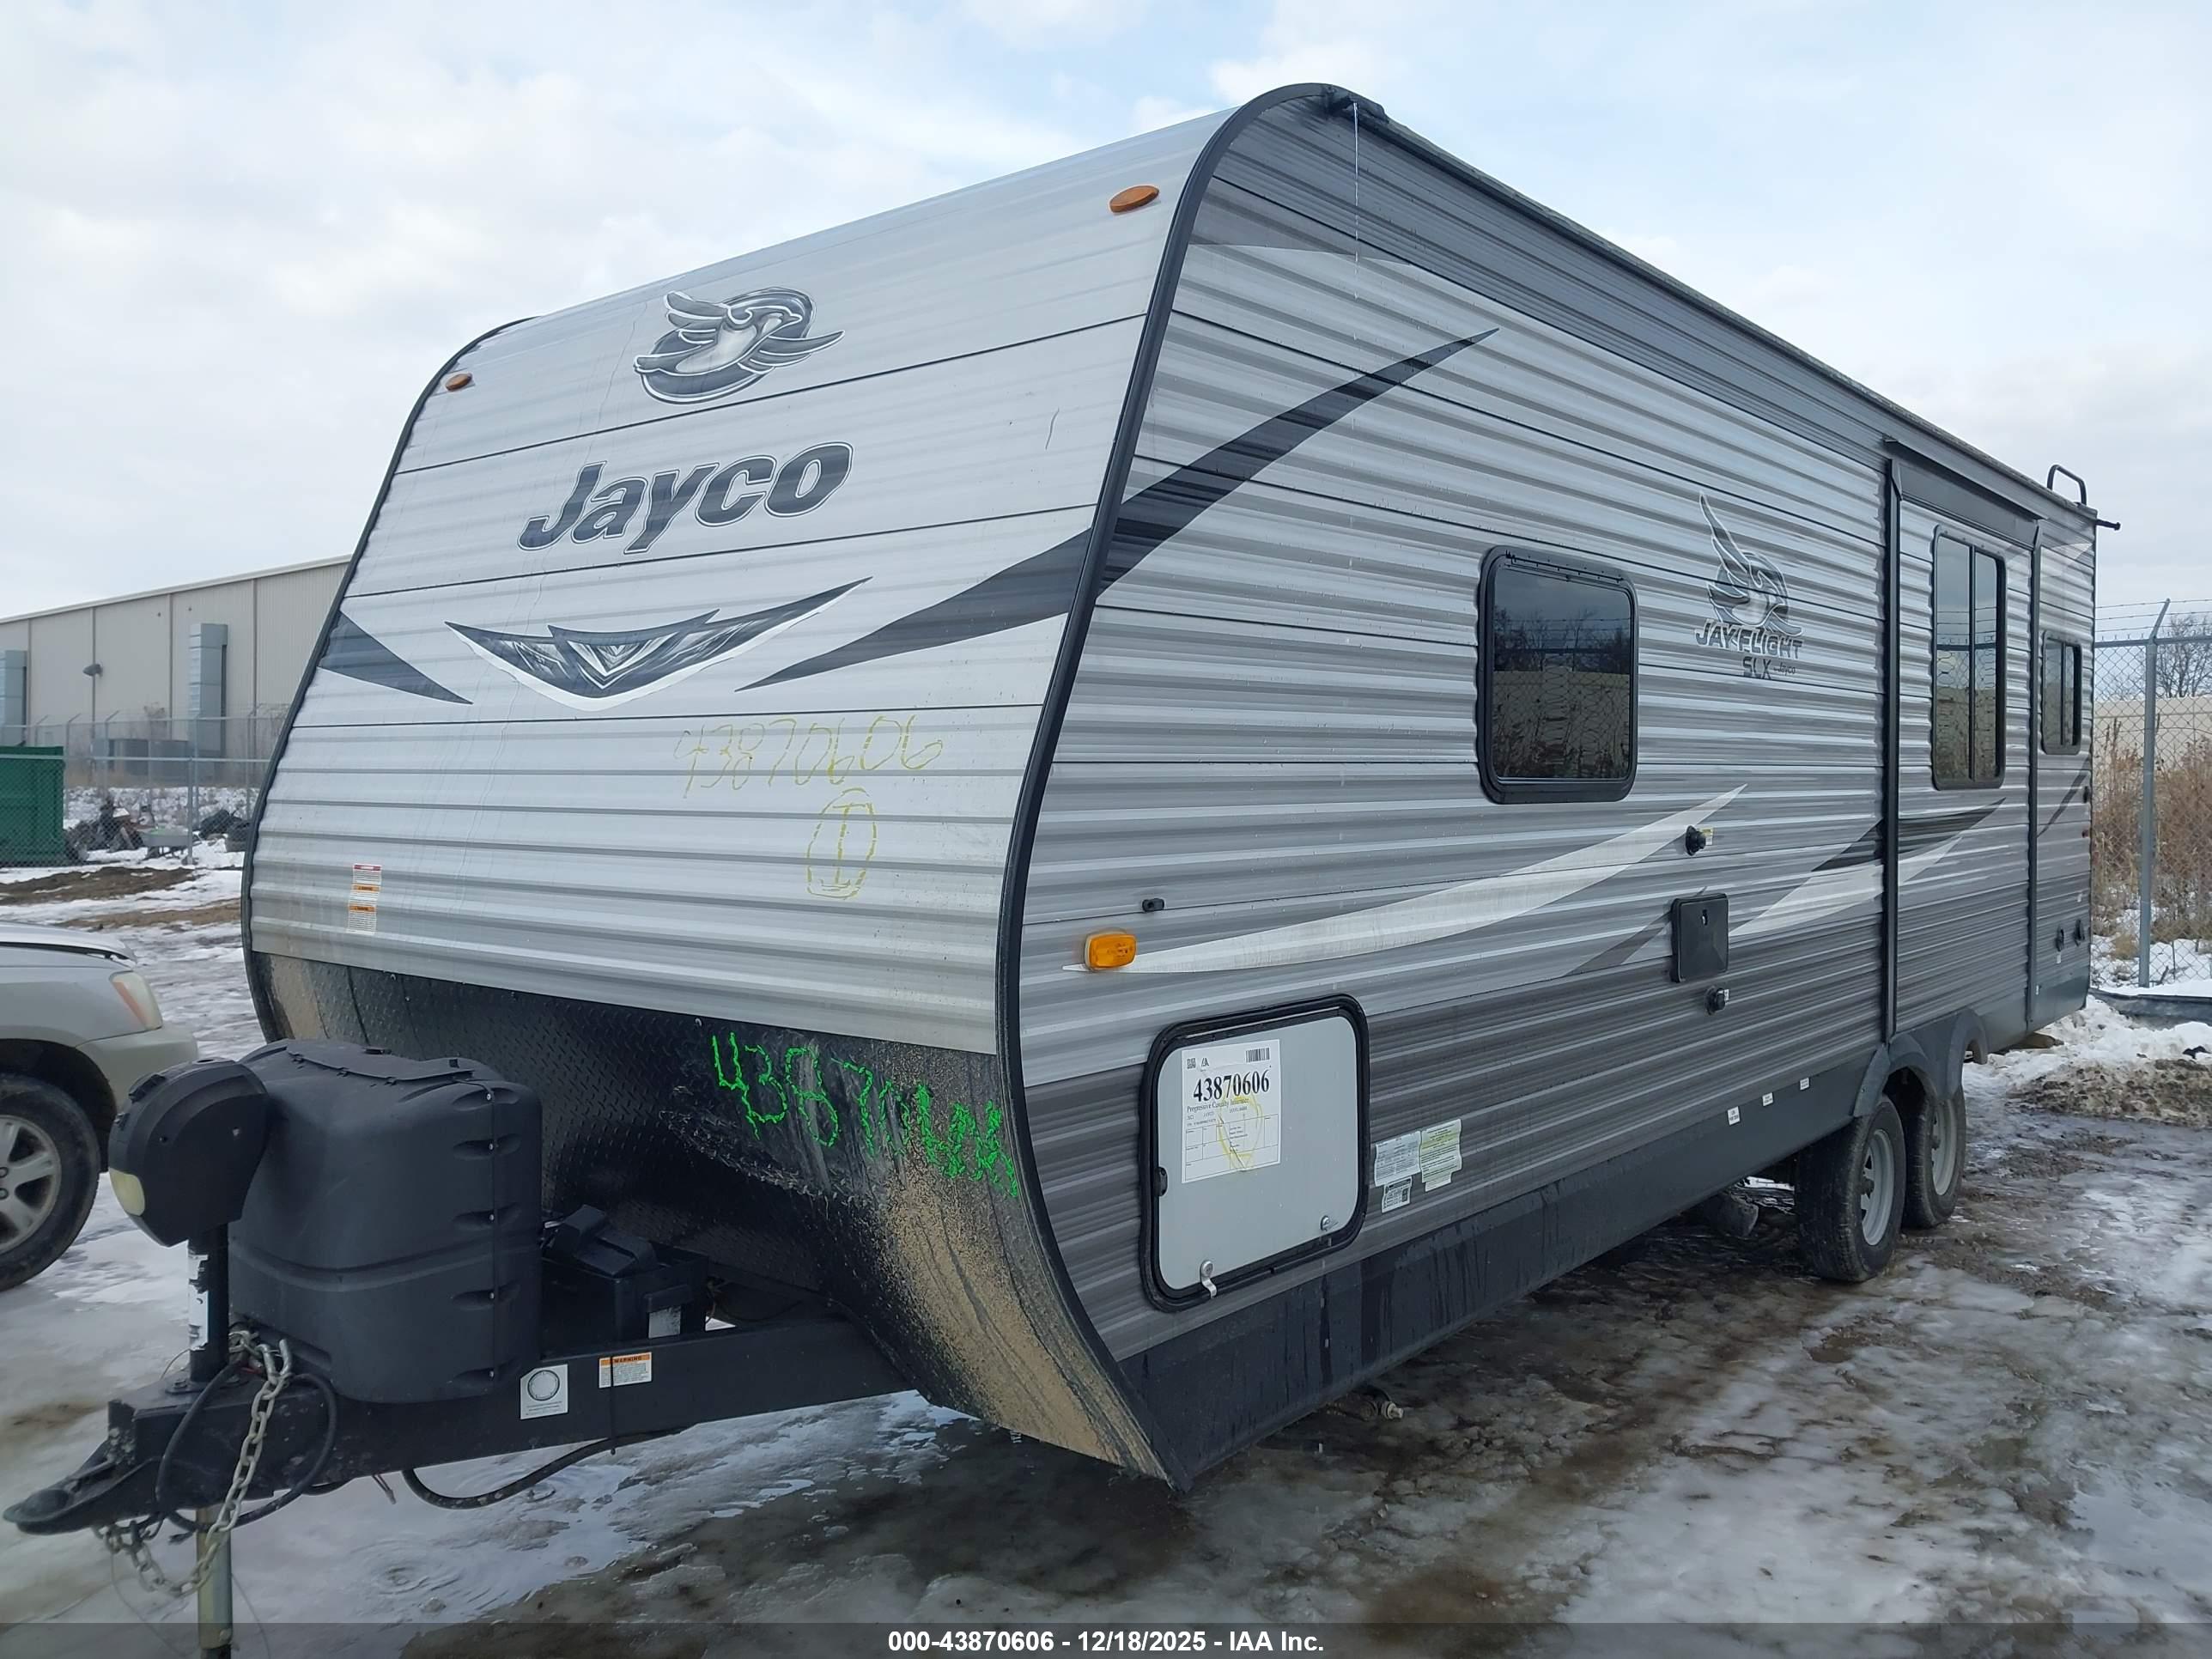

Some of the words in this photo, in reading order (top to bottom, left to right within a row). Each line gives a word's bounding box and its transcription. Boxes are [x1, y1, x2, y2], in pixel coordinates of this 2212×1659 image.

[517, 441, 854, 555] Jayco
[674, 714, 943, 798] 43870606
[1193, 1069, 1270, 1103] 43870606
